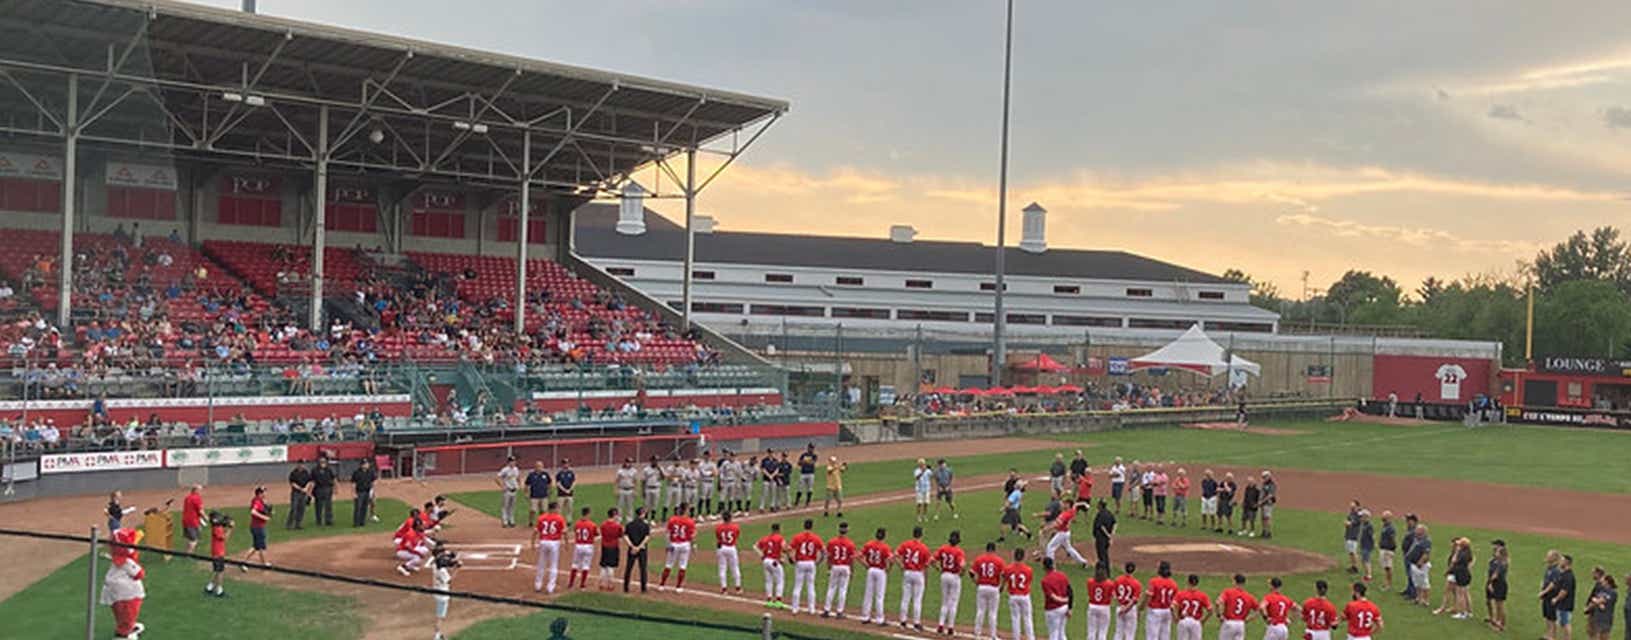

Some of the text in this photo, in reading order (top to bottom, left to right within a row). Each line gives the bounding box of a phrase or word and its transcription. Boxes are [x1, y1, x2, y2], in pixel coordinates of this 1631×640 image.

[1545, 357, 1605, 371] LOUNGE
[541, 521, 557, 535] 26
[799, 541, 815, 554] 49
[834, 545, 847, 560] 33
[980, 562, 994, 577] 18
[1010, 574, 1026, 590] 12
[1095, 587, 1103, 602] 8
[1235, 598, 1244, 614] 3
[1357, 611, 1374, 628] 13
